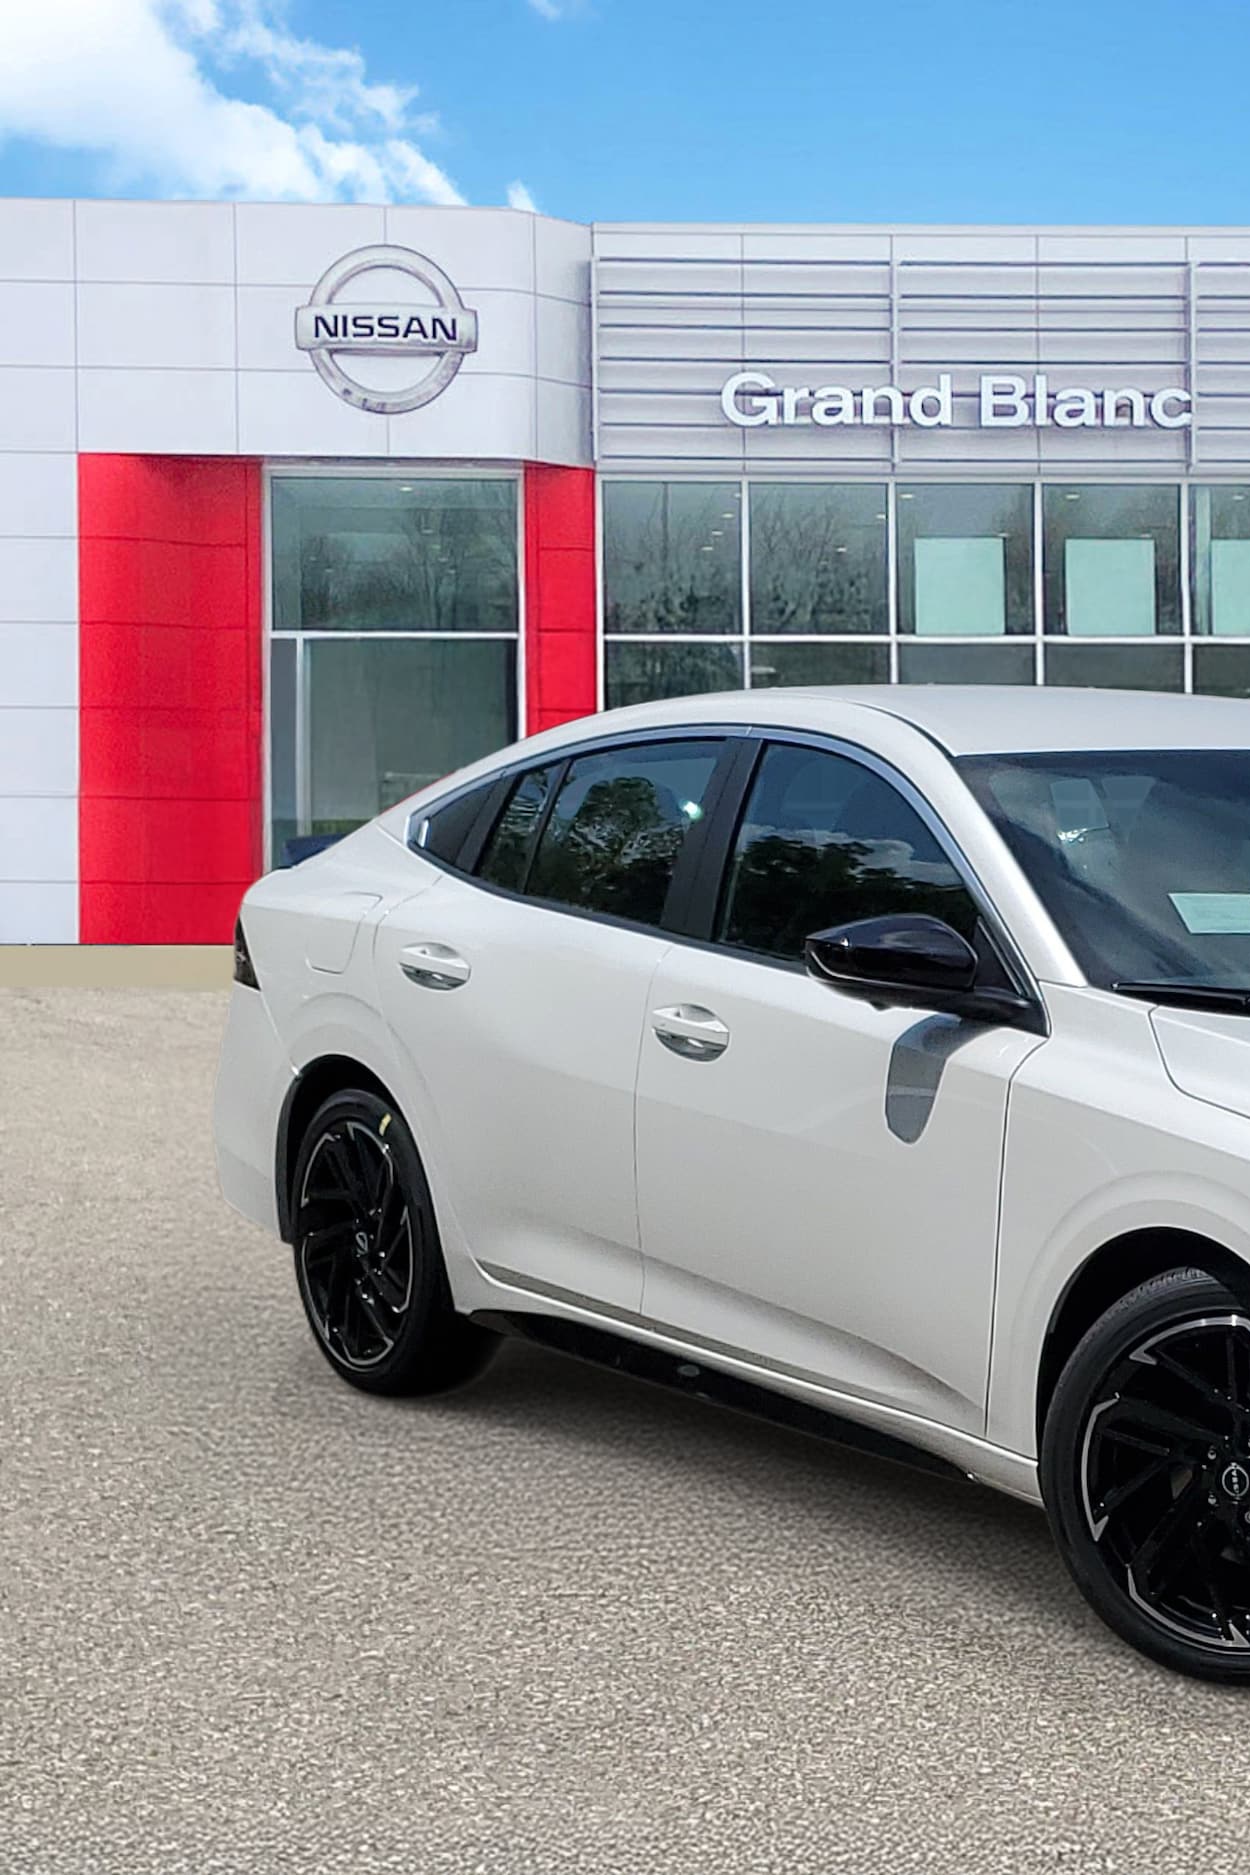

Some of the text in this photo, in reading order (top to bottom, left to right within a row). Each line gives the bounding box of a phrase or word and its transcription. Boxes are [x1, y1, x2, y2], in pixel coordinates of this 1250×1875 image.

[314, 314, 457, 341] NISSAN
[720, 371, 1194, 429] Grand Blanc
